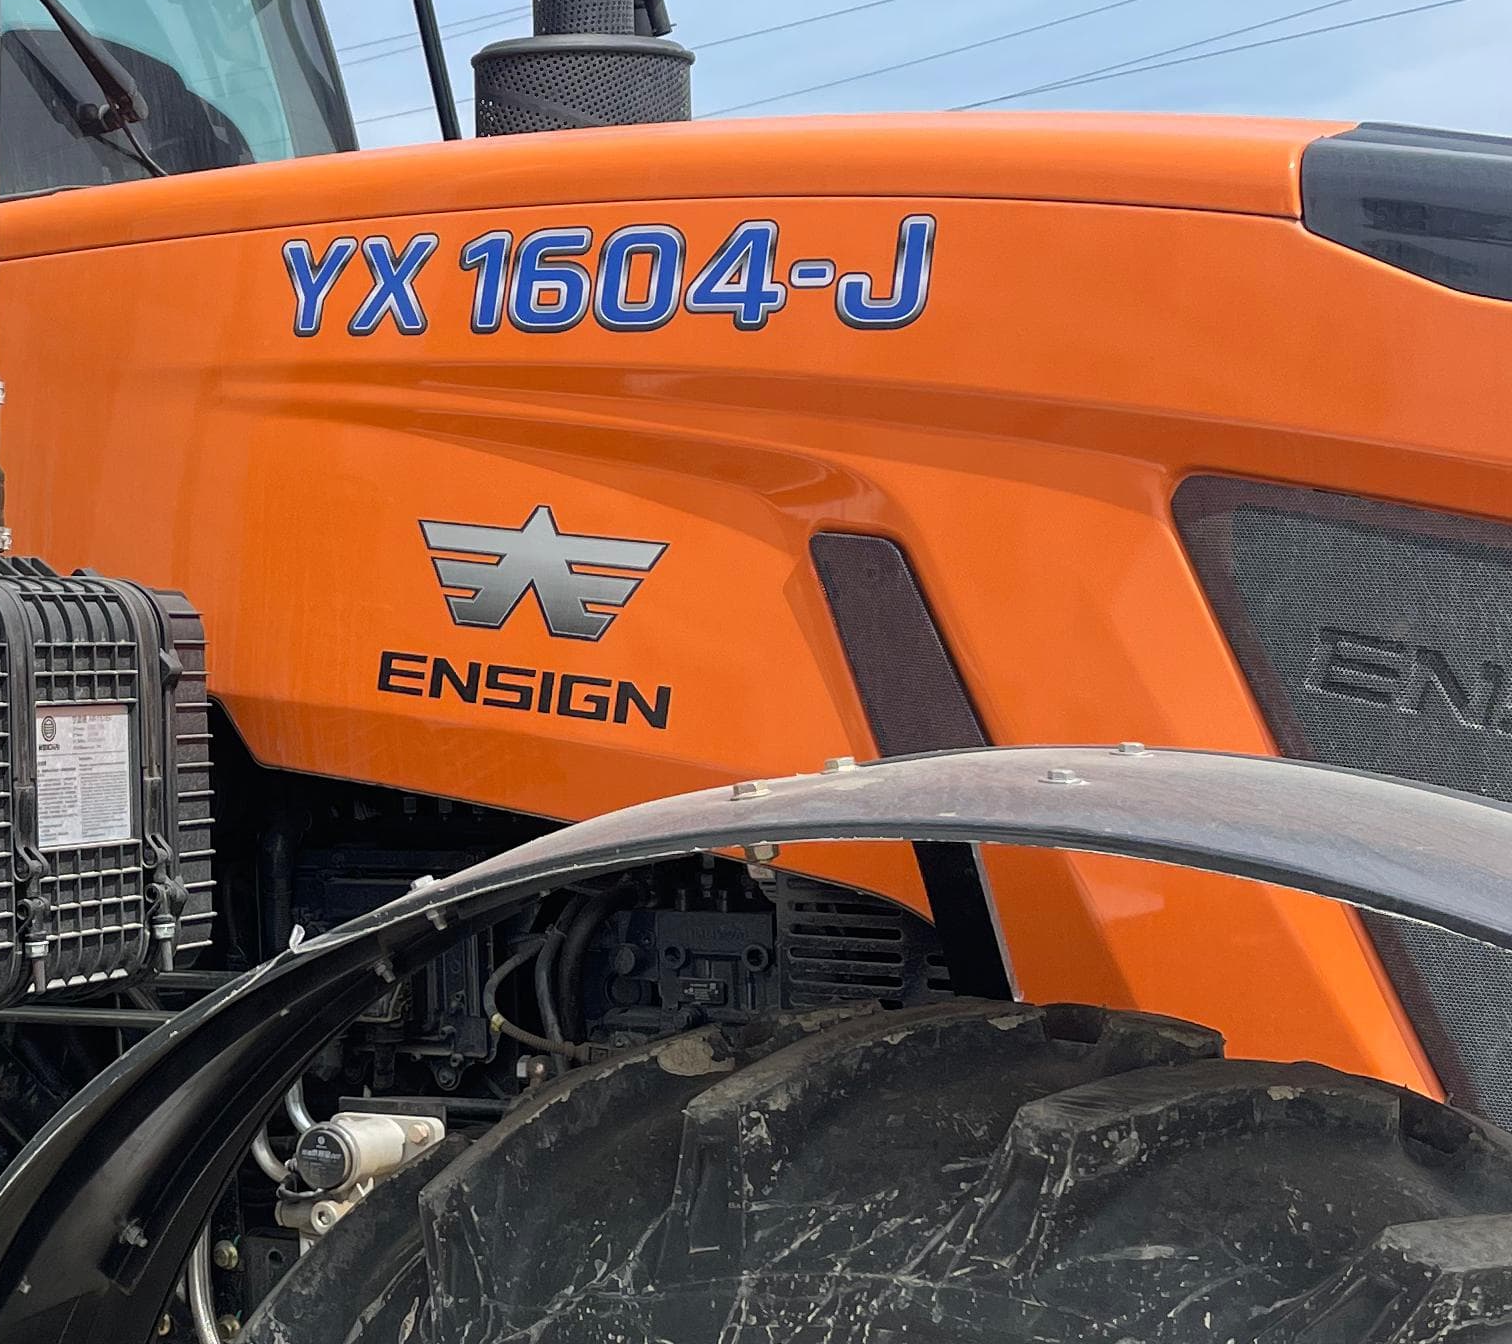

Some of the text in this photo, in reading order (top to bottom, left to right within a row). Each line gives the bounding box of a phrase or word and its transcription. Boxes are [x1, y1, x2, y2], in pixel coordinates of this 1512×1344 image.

[282, 213, 937, 337] YX 1604-J
[377, 651, 673, 730] ENSIGN
